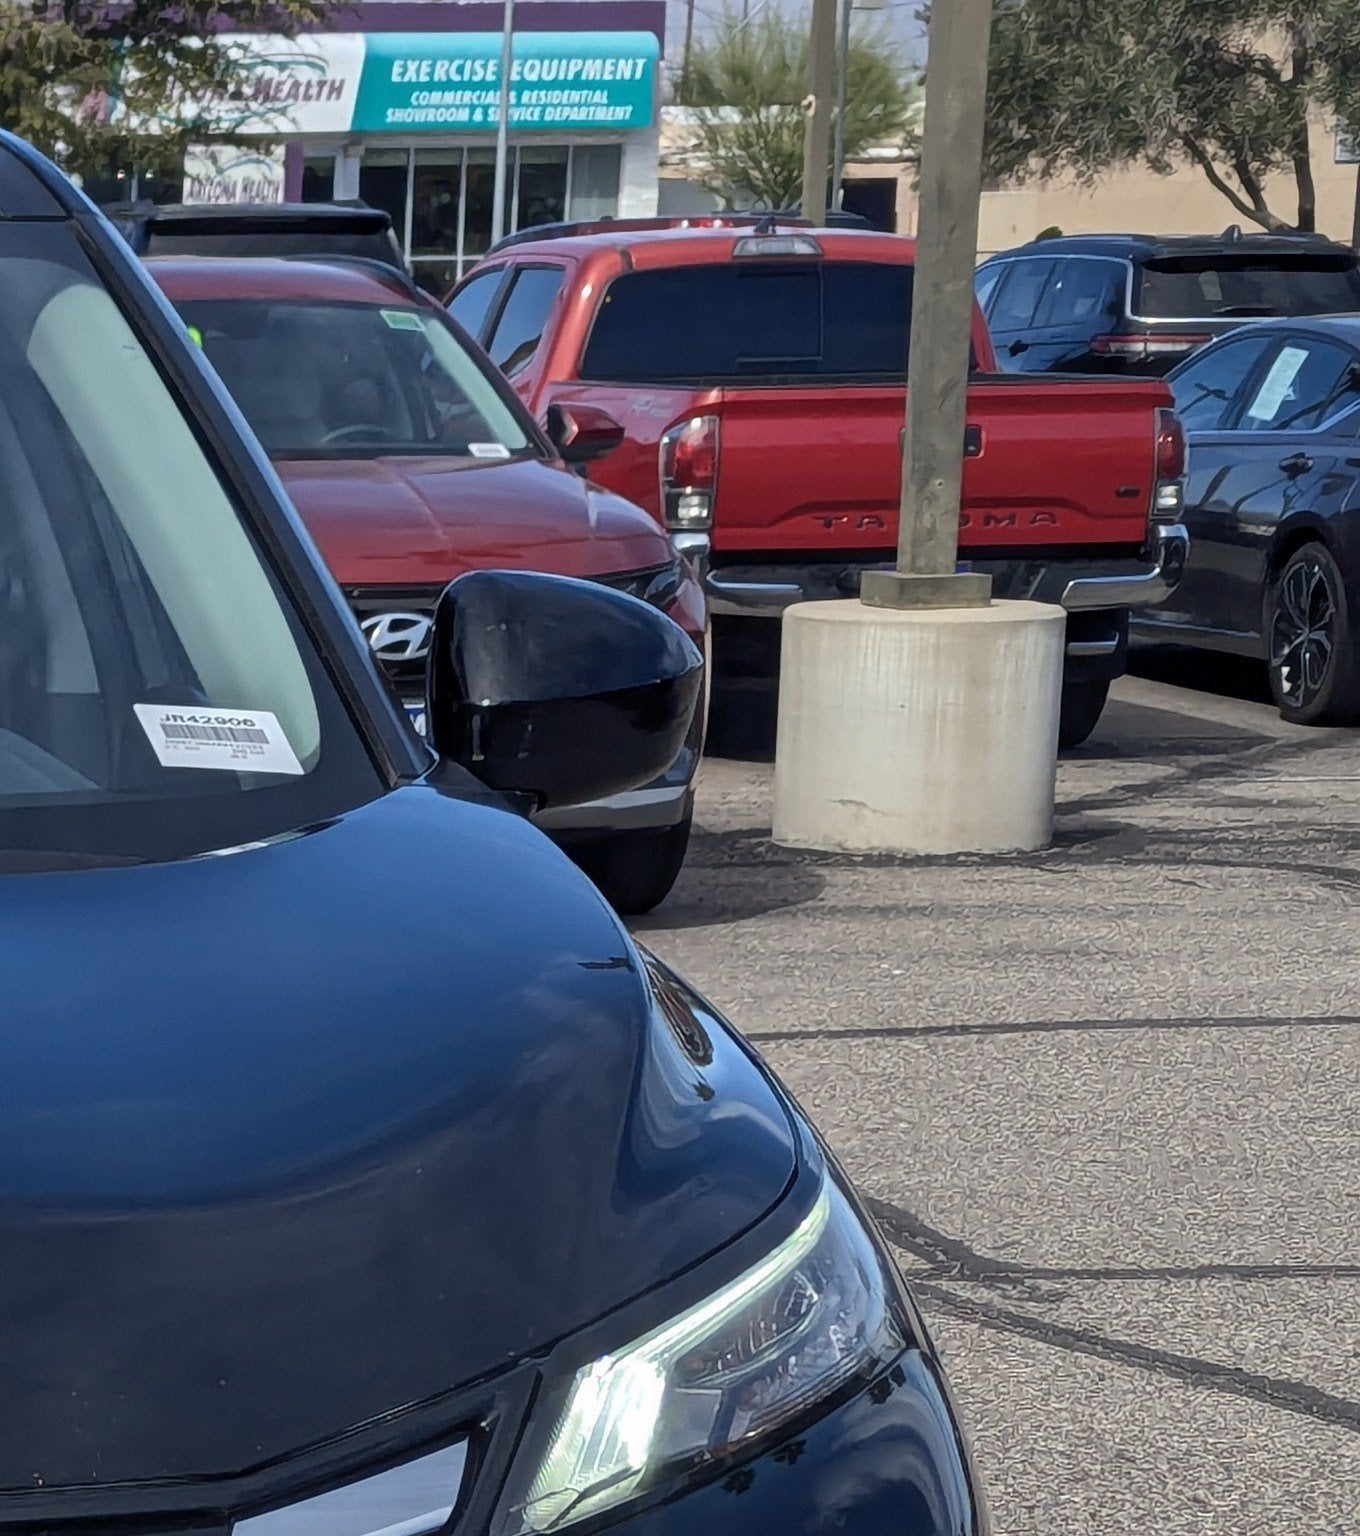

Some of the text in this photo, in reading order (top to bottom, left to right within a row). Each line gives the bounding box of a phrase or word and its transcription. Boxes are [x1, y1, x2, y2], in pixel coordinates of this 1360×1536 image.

[391, 58, 647, 83] EXERCISE EQUIPMENT
[253, 78, 346, 102] HEALTH
[521, 89, 609, 104] RESIDENTIAL
[385, 105, 633, 122] SHOWROOM & SEVICE DEPARTMENT
[813, 510, 1057, 529] TAMA
